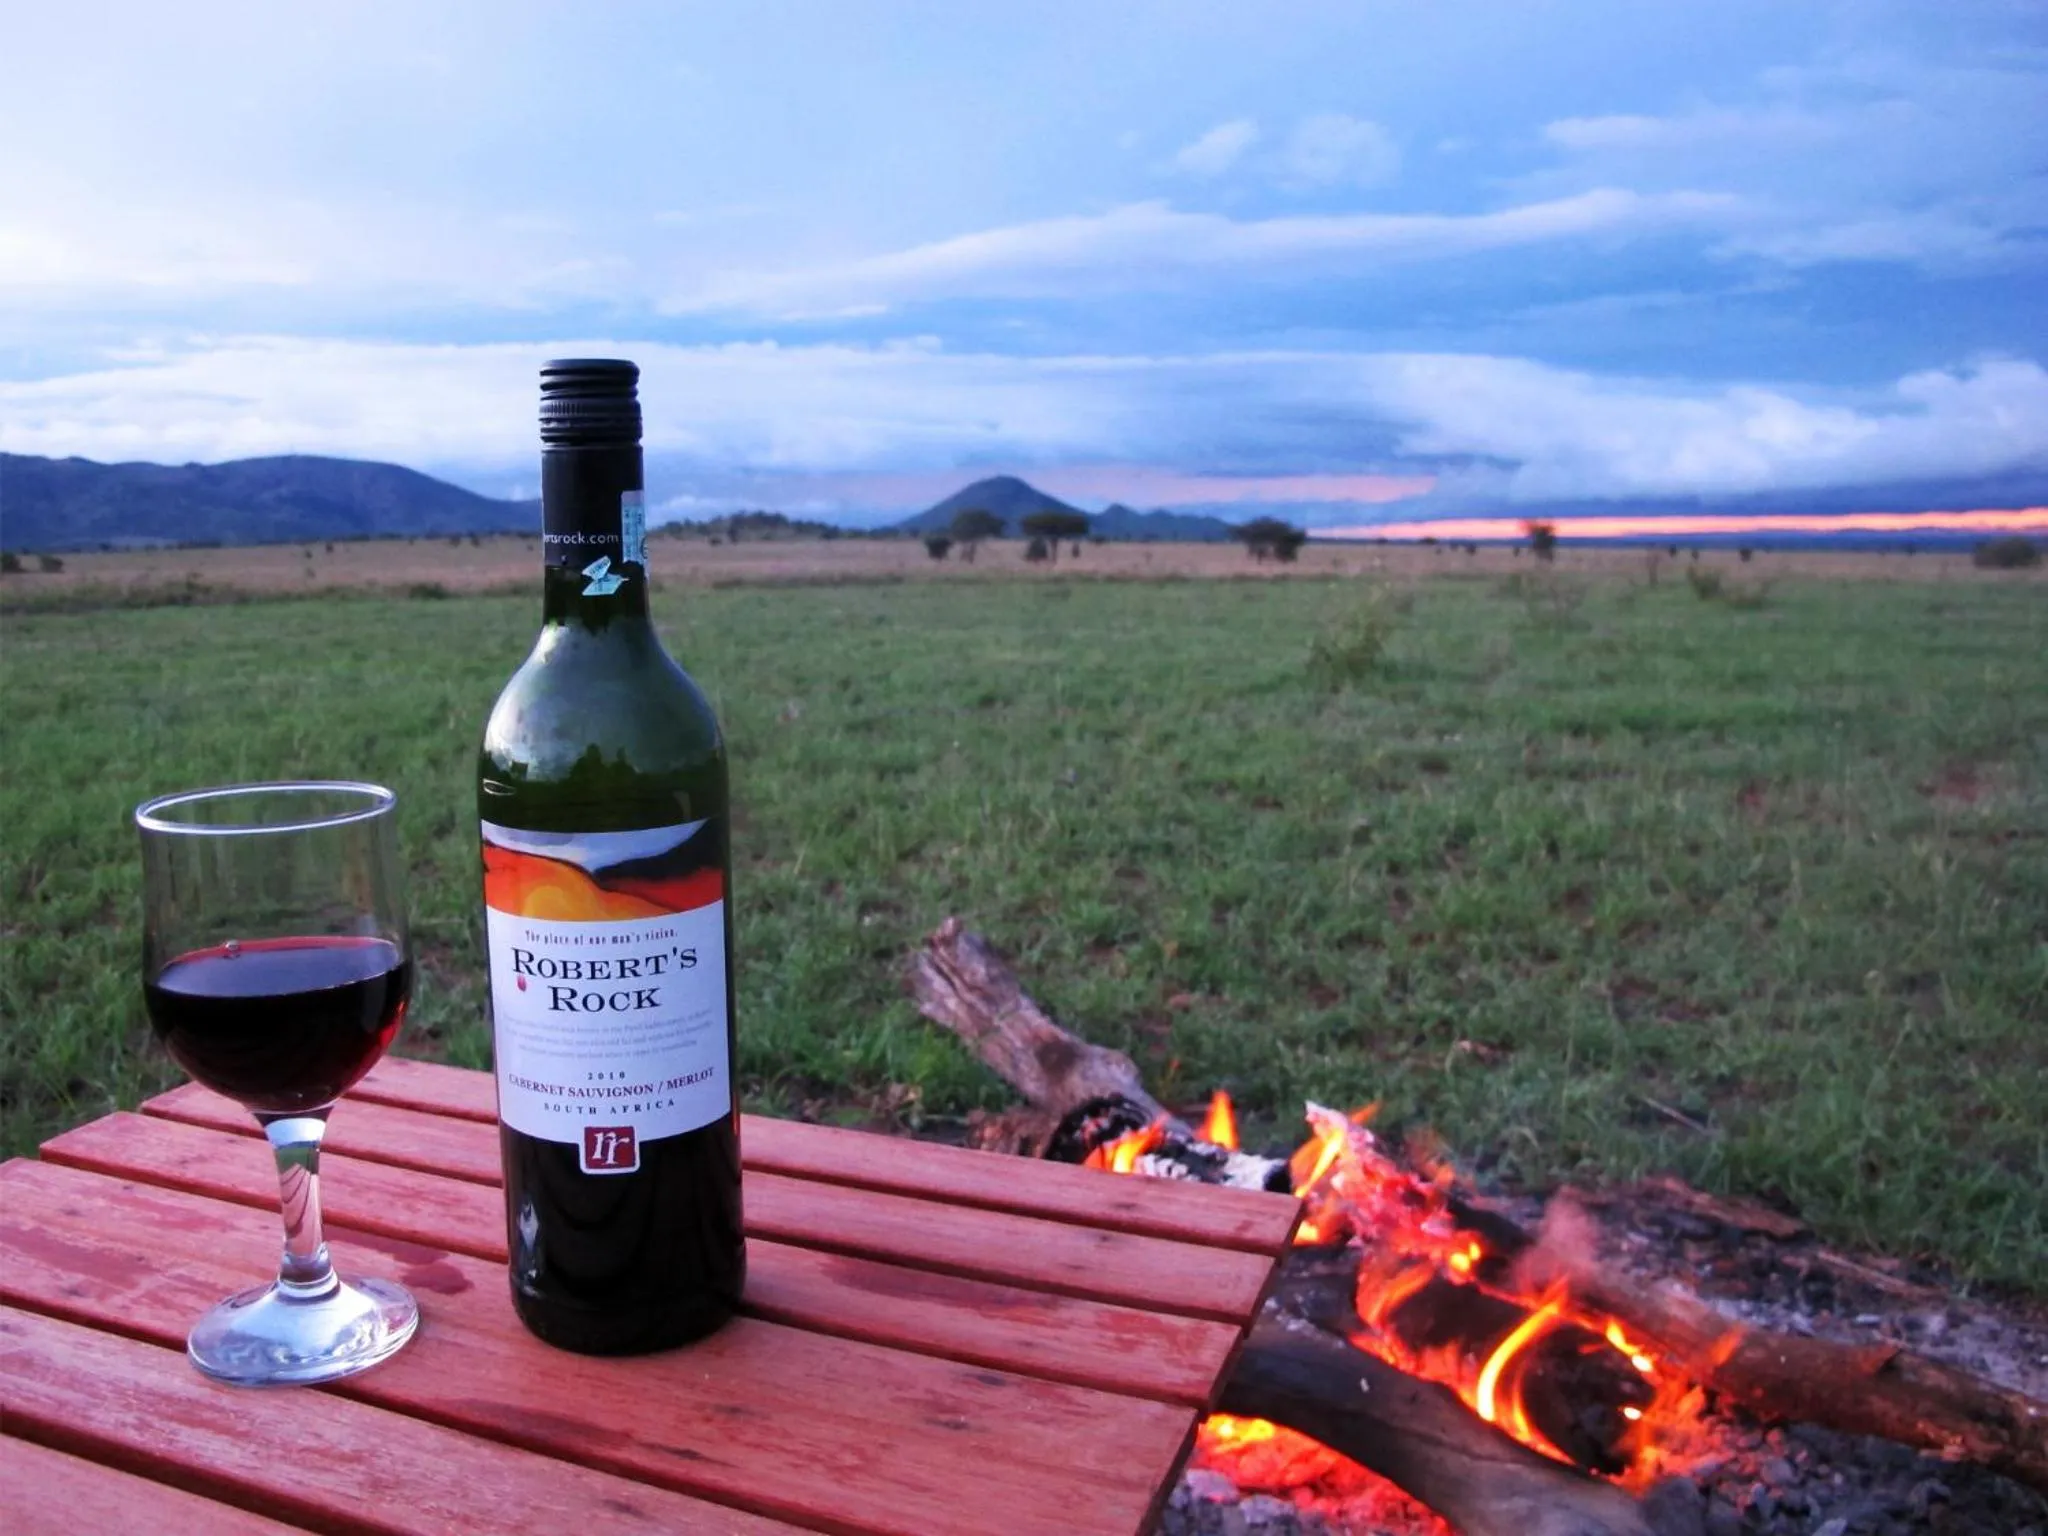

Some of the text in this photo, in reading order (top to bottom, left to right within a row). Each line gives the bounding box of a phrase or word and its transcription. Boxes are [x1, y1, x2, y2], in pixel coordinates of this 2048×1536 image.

[525, 930, 540, 941] The
[544, 933, 569, 945] place
[574, 933, 583, 946] of
[589, 936, 606, 945] one
[511, 946, 698, 980] ROBERT'S
[548, 985, 662, 1013] ROCK
[508, 1073, 565, 1096] CABERNET
[567, 1083, 654, 1098] SAUVIGNON
[667, 1067, 714, 1091] MERLOT
[587, 1070, 626, 1081] 2010
[544, 1099, 675, 1115] SOUTH AFRICA
